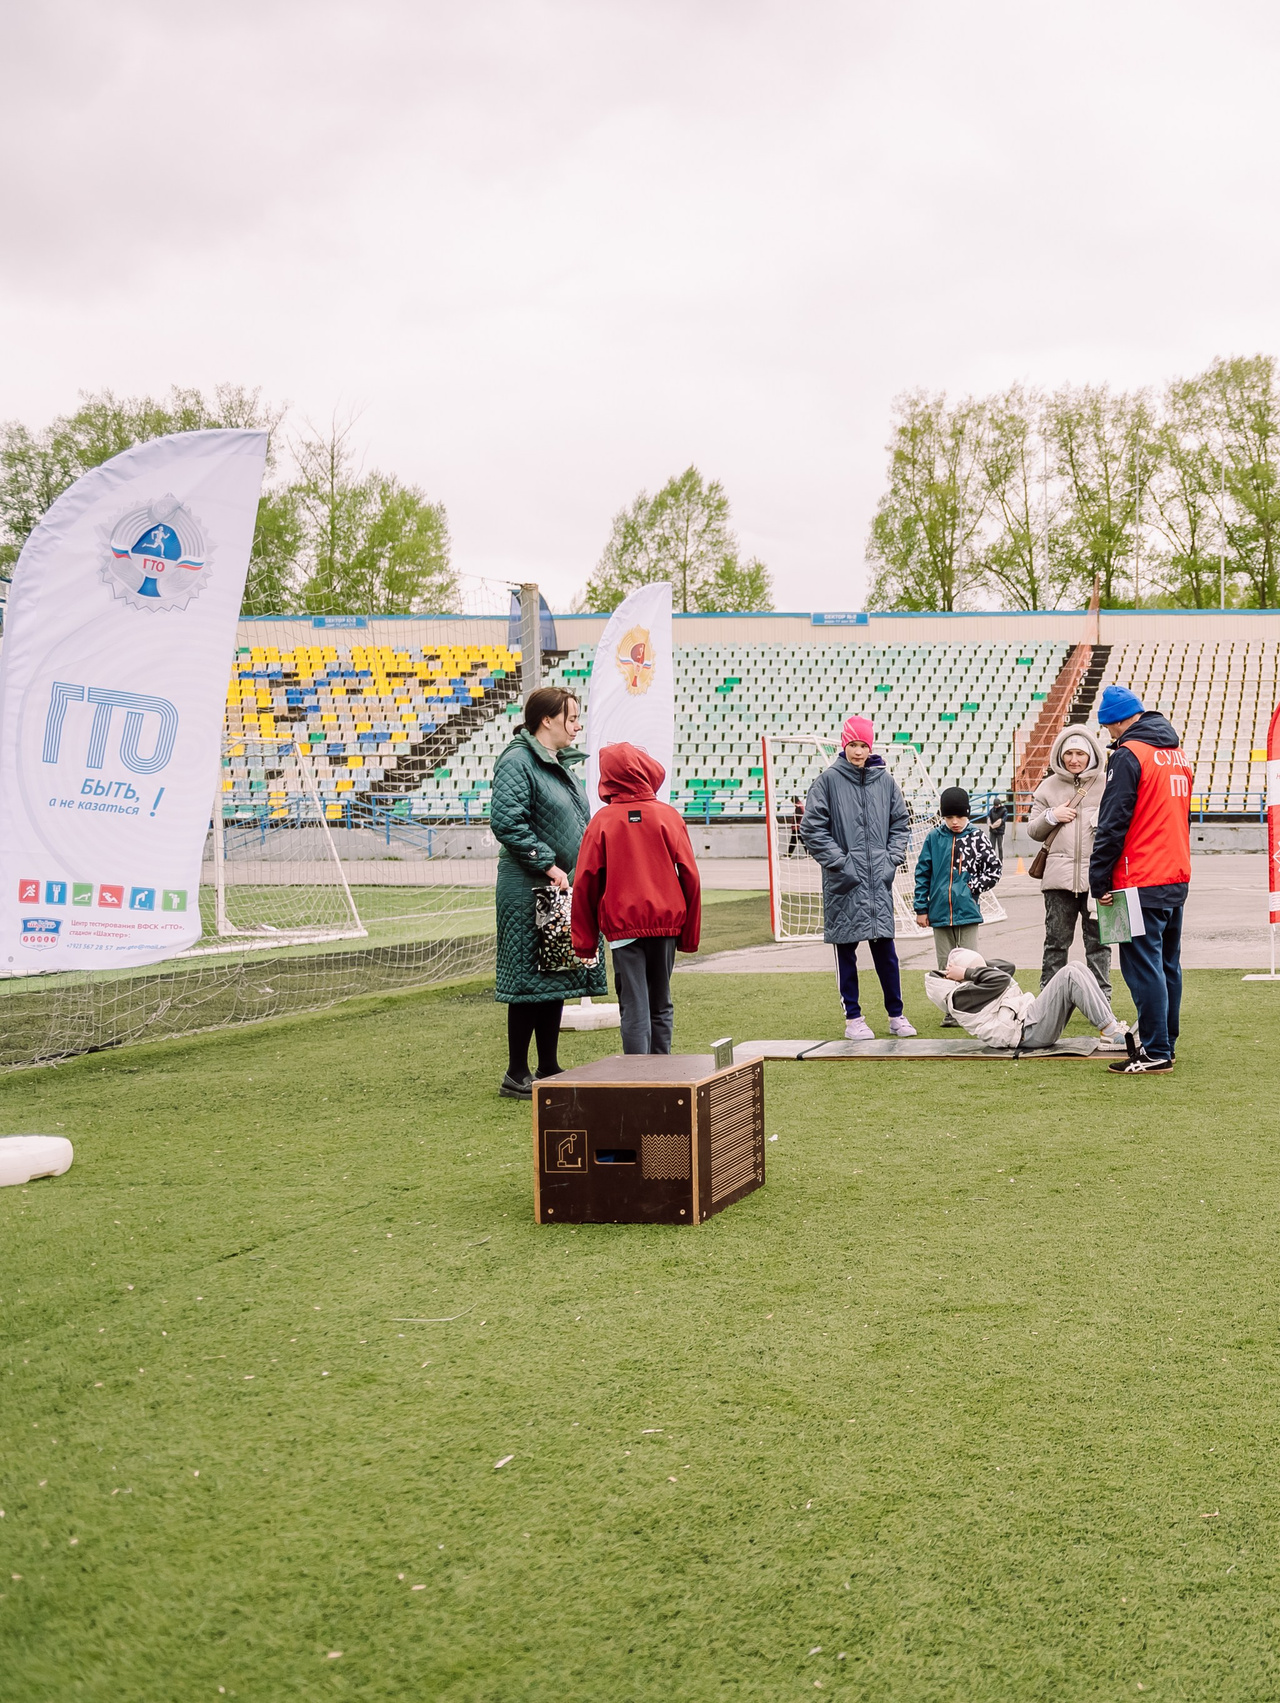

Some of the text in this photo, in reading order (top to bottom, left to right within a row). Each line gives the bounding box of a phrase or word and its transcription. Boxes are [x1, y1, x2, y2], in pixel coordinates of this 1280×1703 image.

[143, 558, 166, 573] ГТО
[550, 657, 559, 666] 17
[1074, 687, 1082, 695] 13
[1070, 696, 1079, 704] 12
[1066, 704, 1073, 712] 11
[42, 681, 179, 775] ГТО
[81, 778, 140, 803] БЫТЬ,
[1169, 774, 1189, 798] ГТО
[49, 798, 140, 815] а не казаться
[71, 920, 88, 928] Центр
[89, 921, 135, 930] тестирования
[93, 930, 131, 939] «Шахтер»:
[755, 1103, 760, 1114] 15
